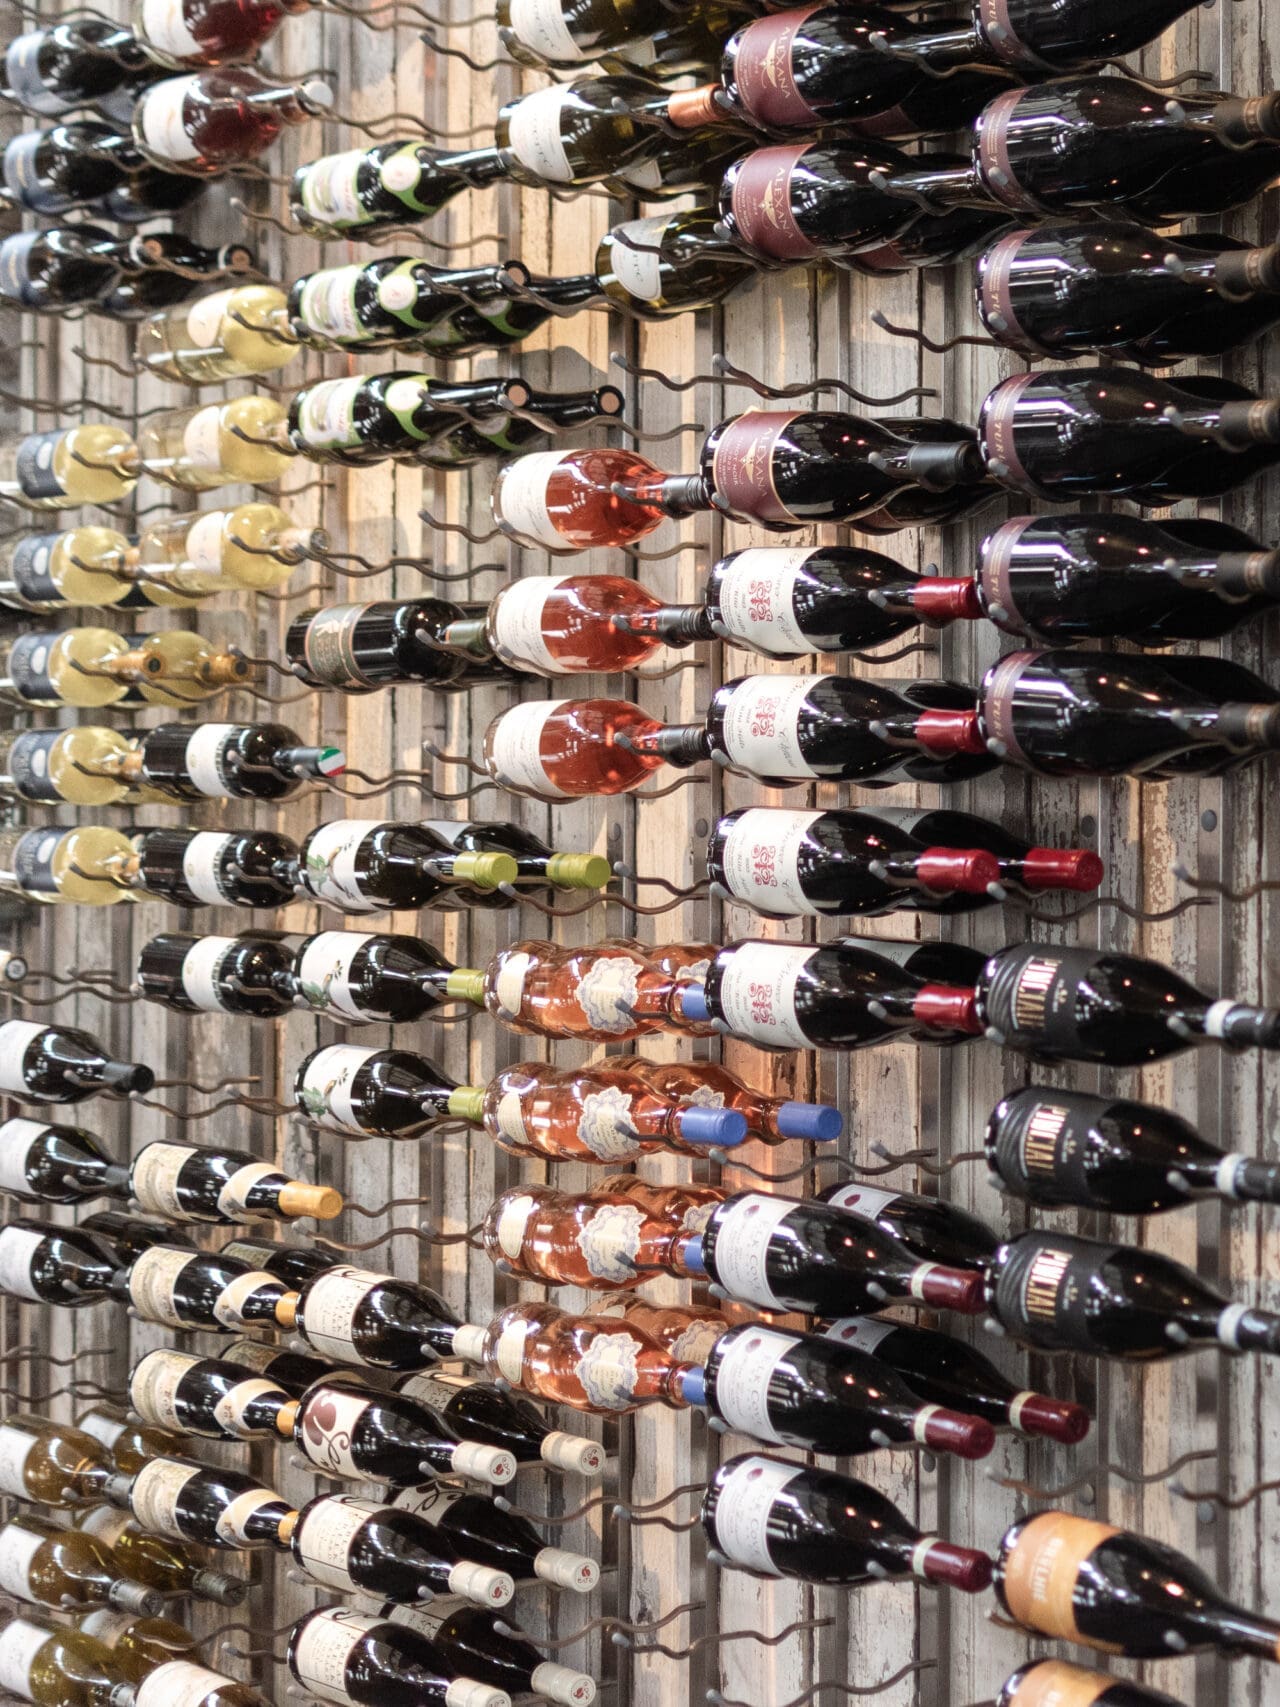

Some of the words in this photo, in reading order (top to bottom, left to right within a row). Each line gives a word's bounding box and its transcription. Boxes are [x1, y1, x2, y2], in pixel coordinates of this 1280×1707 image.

[775, 26, 791, 98] ALEXANA
[774, 167, 793, 238] ALEXANA
[756, 427, 774, 497] ALEXANA
